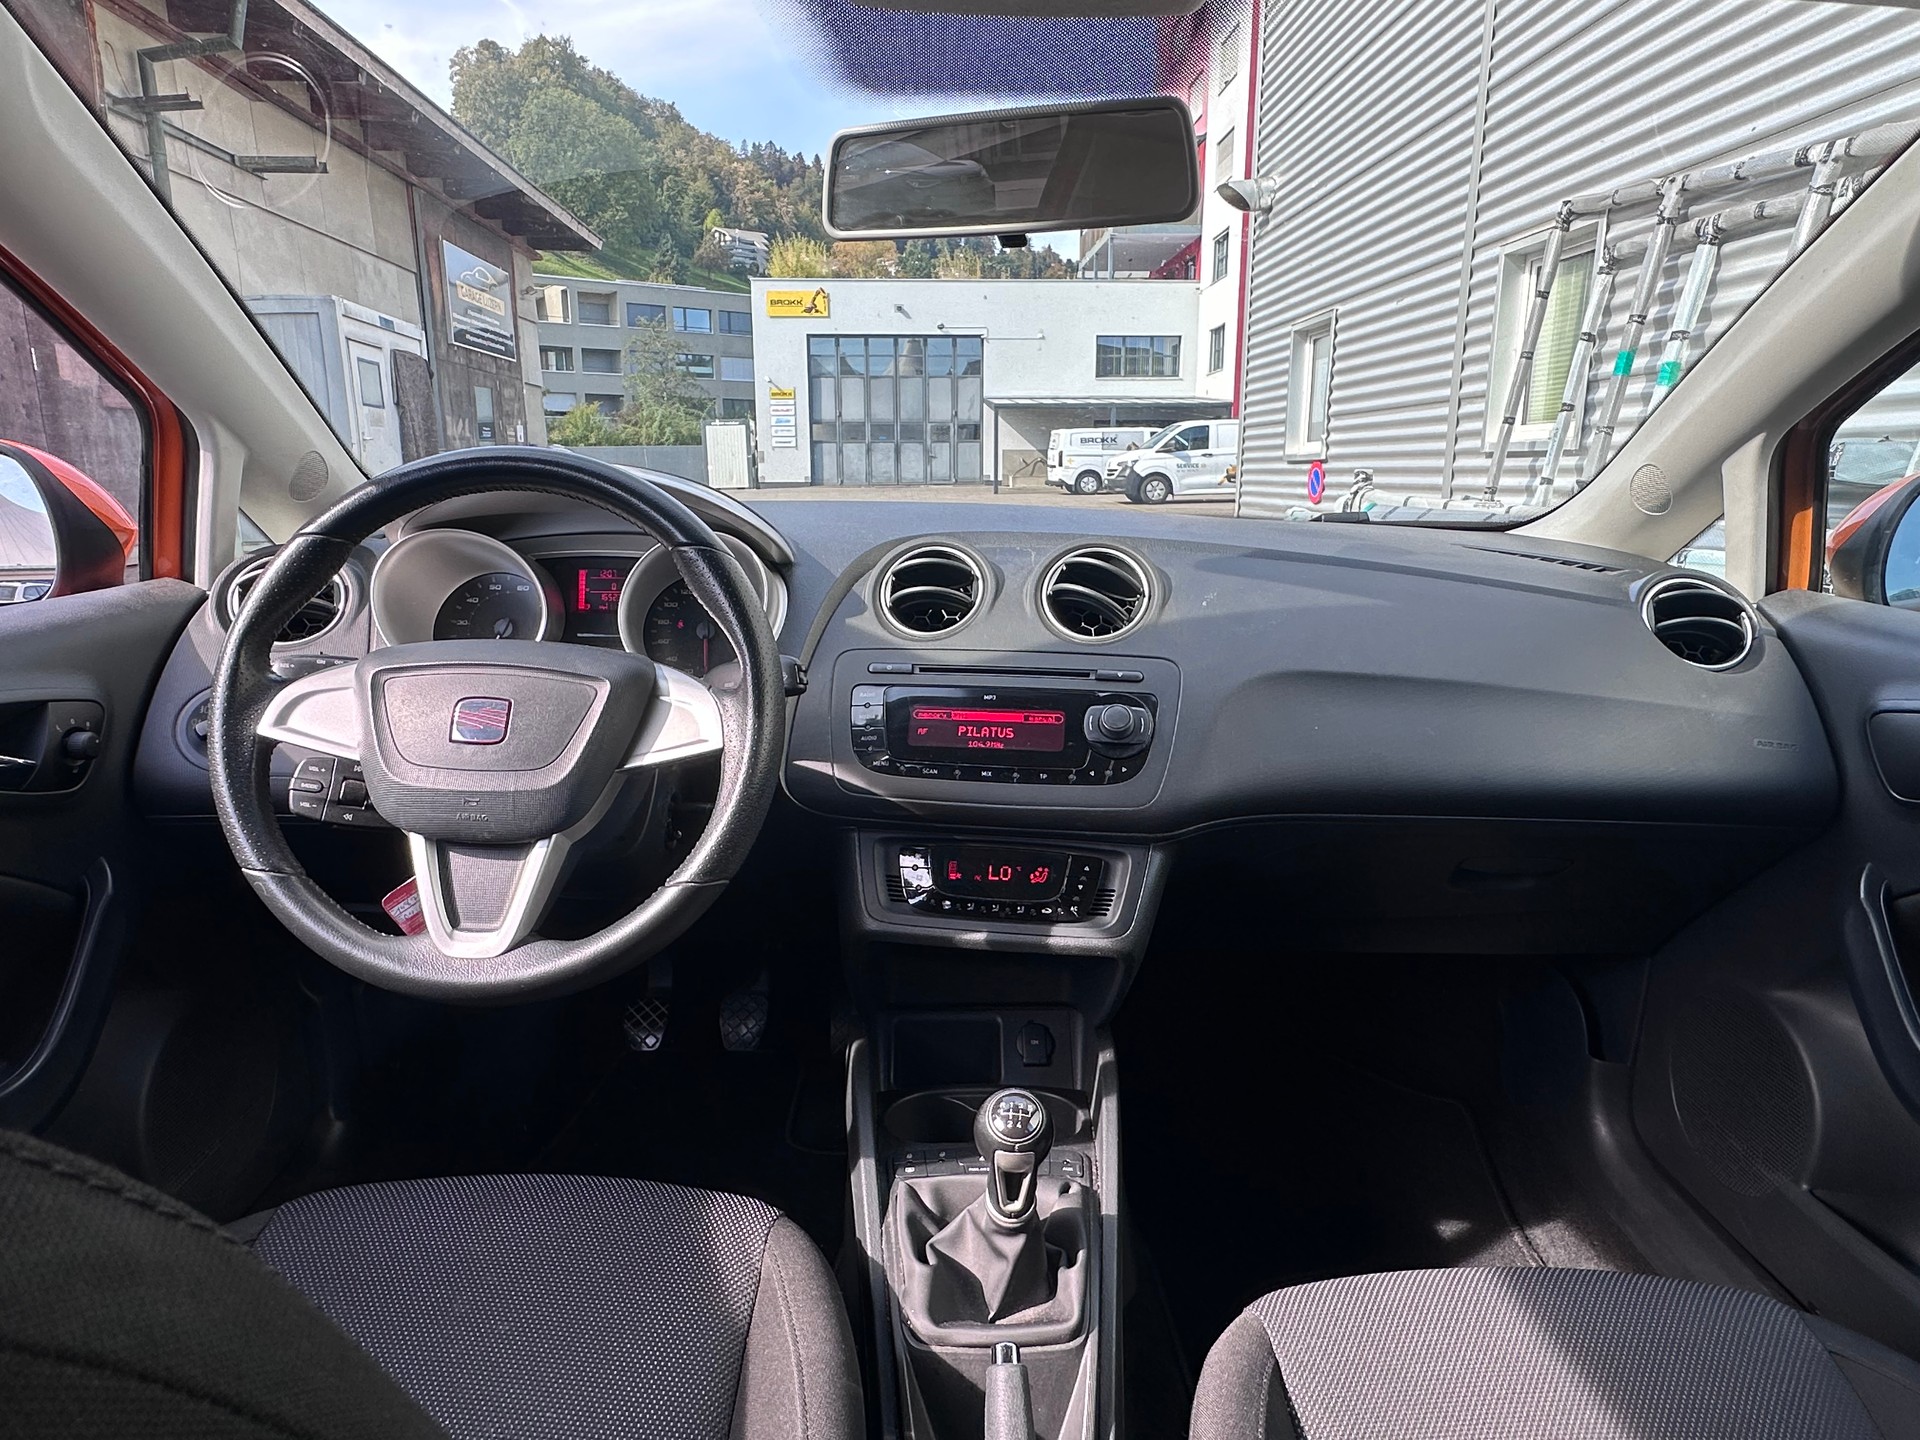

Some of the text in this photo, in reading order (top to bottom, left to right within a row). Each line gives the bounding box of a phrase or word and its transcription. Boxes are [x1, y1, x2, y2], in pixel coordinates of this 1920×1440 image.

[957, 725, 1015, 738] PILATUS
[456, 813, 489, 822] AIRBAG
[988, 864, 1012, 881] LO
